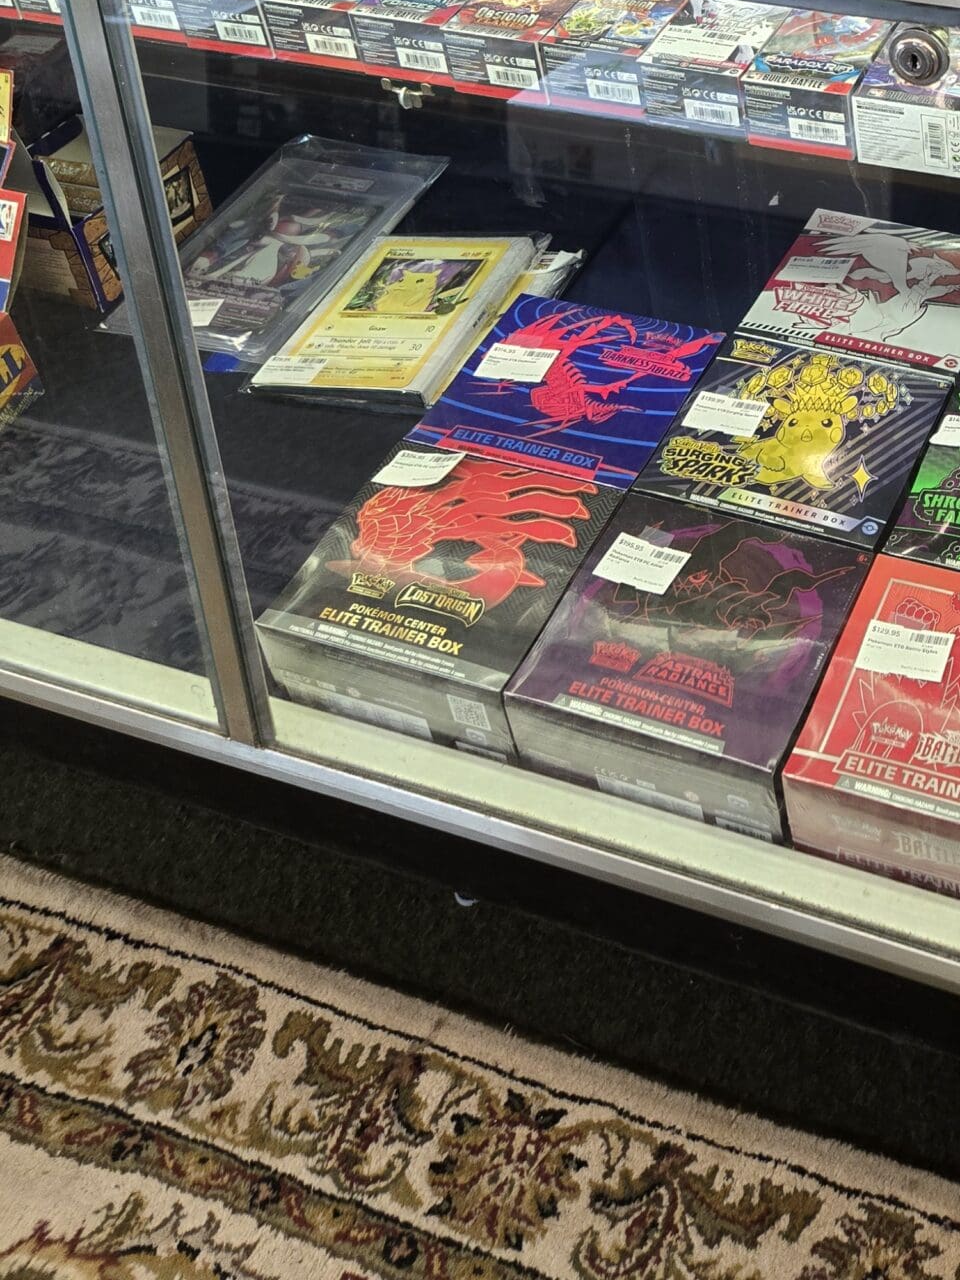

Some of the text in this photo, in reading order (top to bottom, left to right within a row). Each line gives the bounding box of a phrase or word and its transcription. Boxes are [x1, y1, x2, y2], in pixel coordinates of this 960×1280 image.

[475, 6, 540, 27] OBSIDIAN
[774, 300, 836, 320] FLARE
[780, 288, 849, 311] WHITE
[329, 337, 423, 351] Thunder 30
[824, 334, 931, 363] ELITE TRAINER BOX
[599, 350, 650, 369] DARKNESS
[452, 428, 595, 468] ELITE TRAINER BOX
[665, 447, 746, 468] SURGING
[671, 458, 754, 486] SPARKS
[730, 492, 847, 526] ELITE TRAINER BOX
[398, 586, 482, 622] LOST ORIGIN
[319, 607, 464, 656] ELITE TRAINER BOX
[348, 603, 448, 636] POKÉMON CENTER
[871, 625, 901, 638] $129.95
[569, 680, 726, 736] ELITE TRAINER BOX
[845, 757, 895, 780] ELITE
